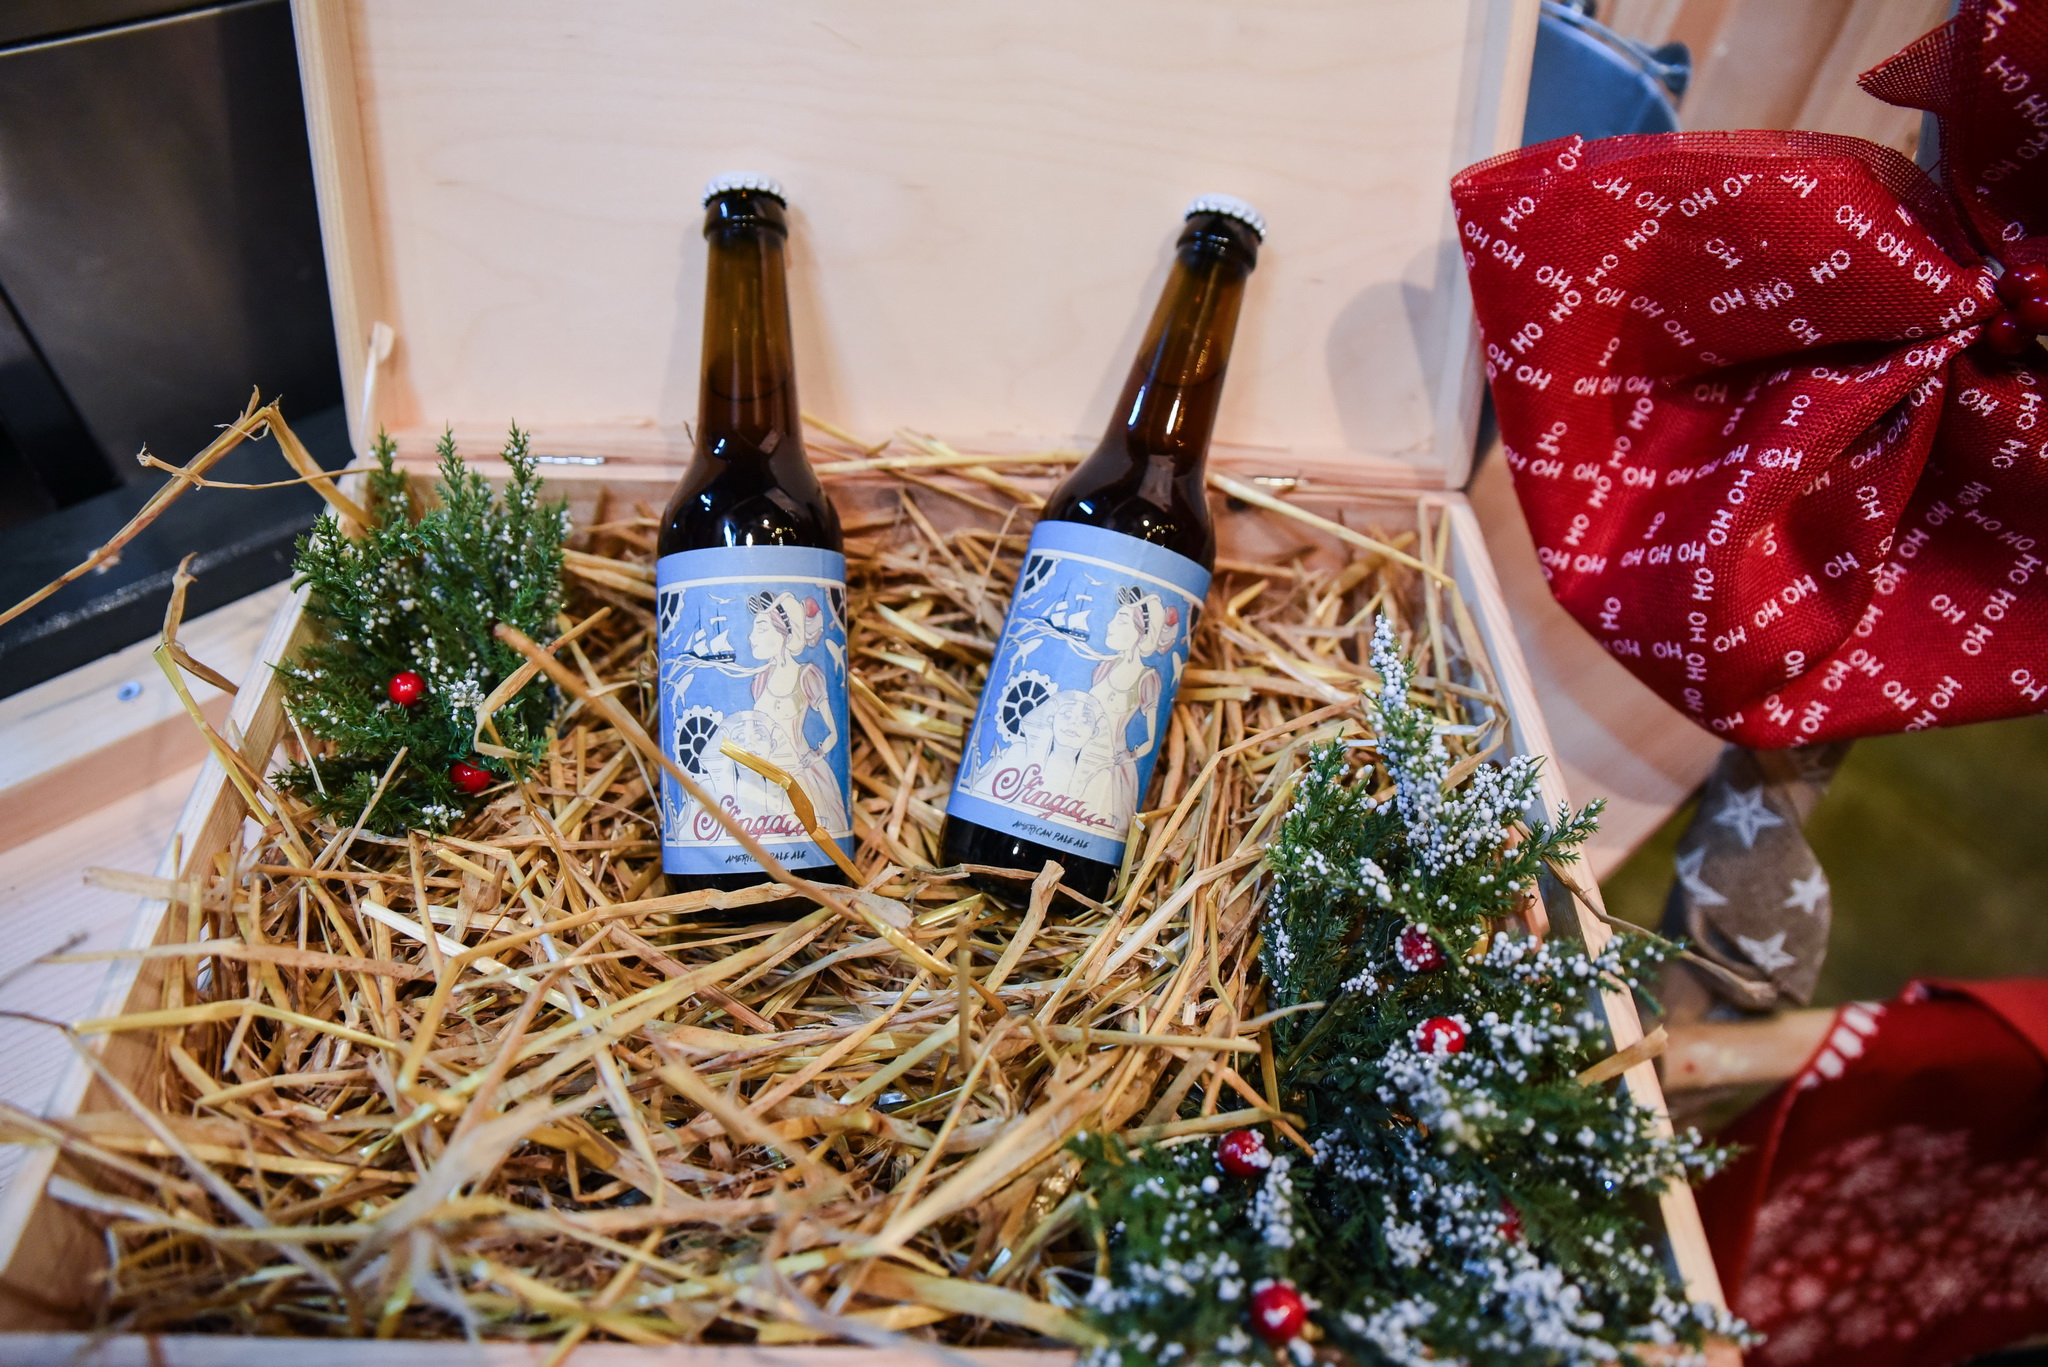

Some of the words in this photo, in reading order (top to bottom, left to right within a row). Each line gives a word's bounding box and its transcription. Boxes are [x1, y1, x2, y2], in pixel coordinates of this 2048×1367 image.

[1012, 820, 1052, 838] AMERICAN
[1053, 832, 1073, 844] PALE
[1073, 838, 1090, 849] ALE
[790, 850, 807, 860] ALE
